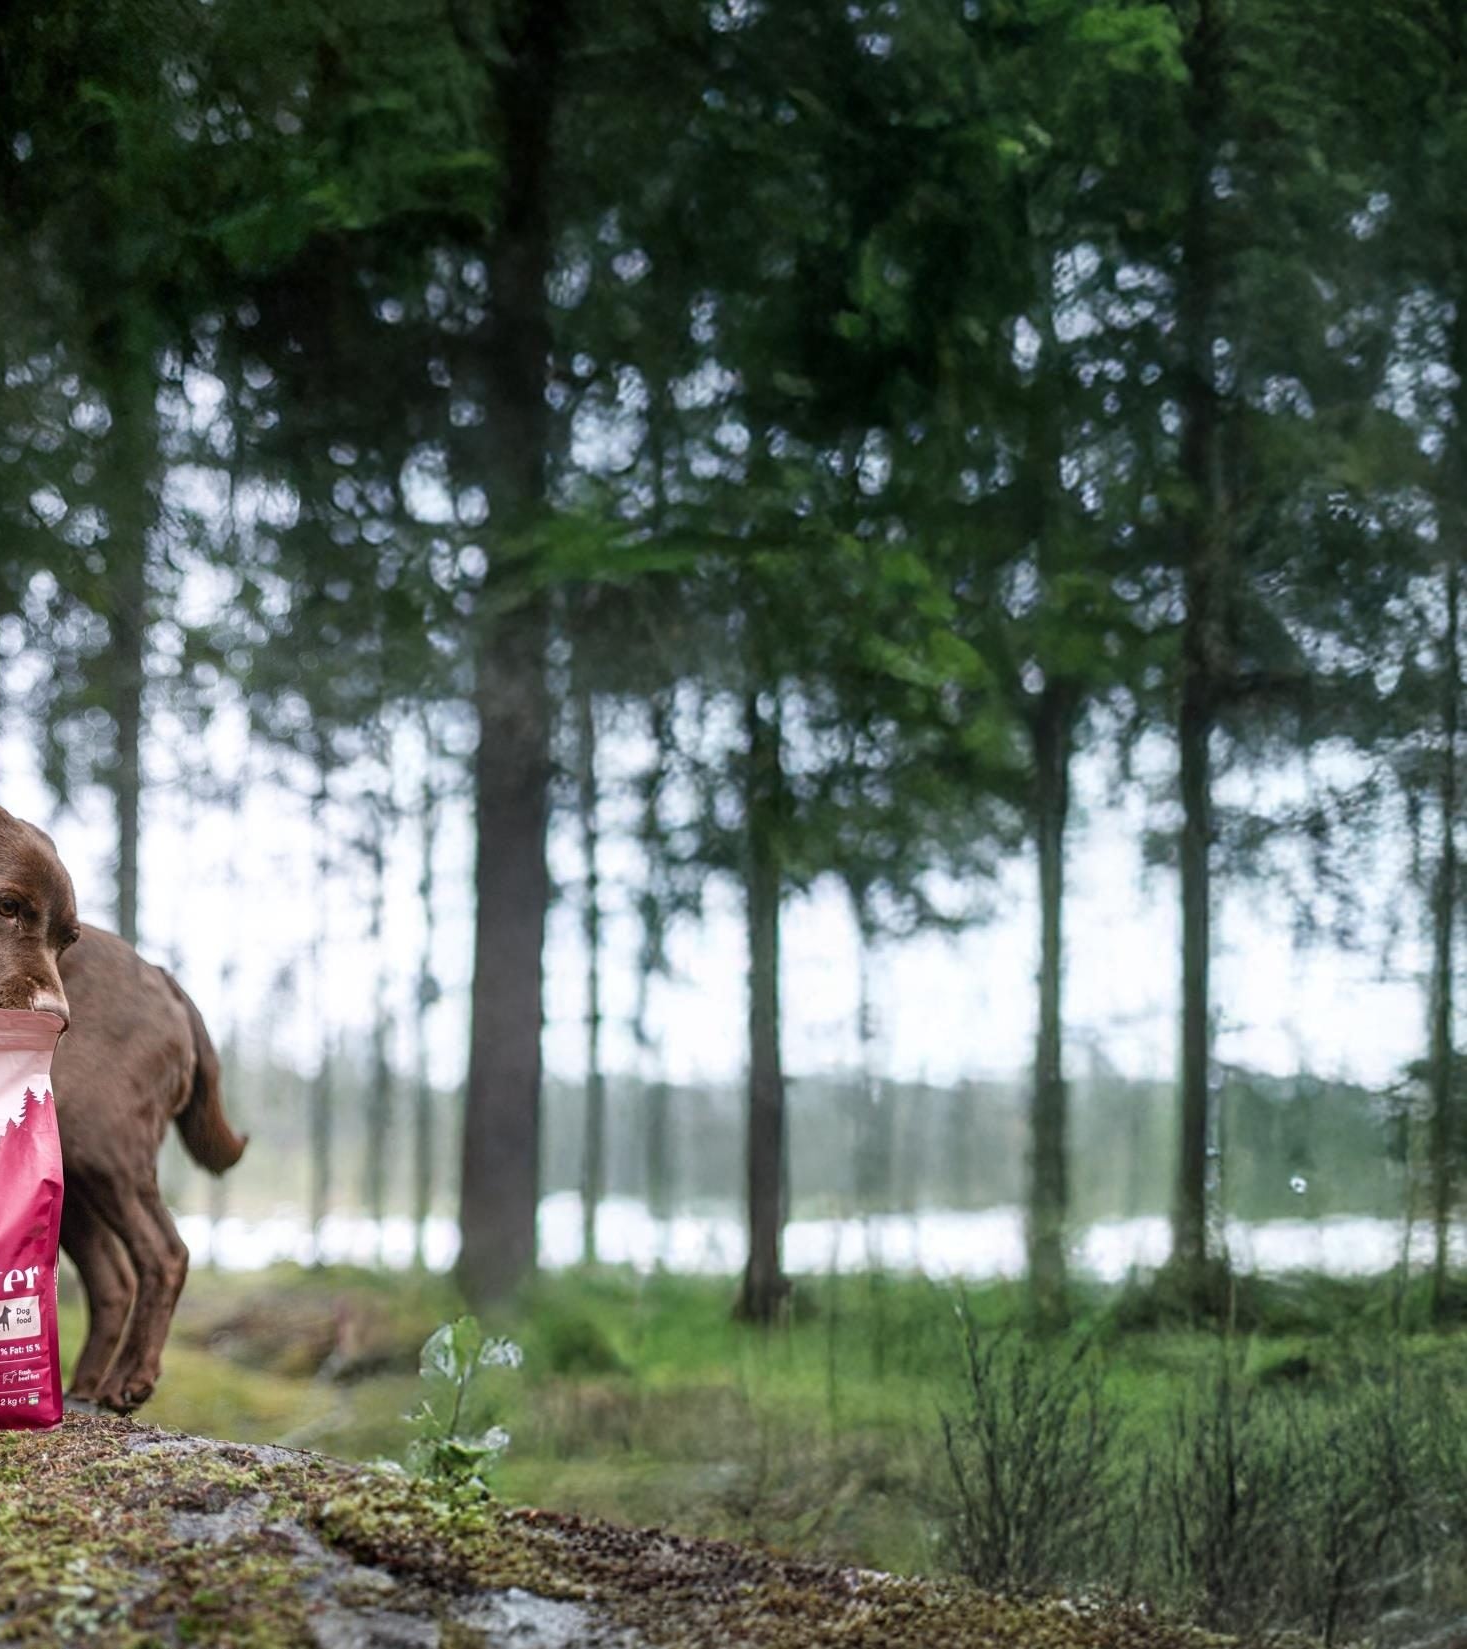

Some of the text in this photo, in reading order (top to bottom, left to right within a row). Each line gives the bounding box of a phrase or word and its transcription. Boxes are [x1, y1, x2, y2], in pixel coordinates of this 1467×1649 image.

[16, 1307, 31, 1316] Dog
[16, 1317, 32, 1325] food
[9, 1346, 25, 1355] Fat:
[26, 1344, 34, 1353] 15
[0, 1398, 6, 1406] 2
[7, 1397, 18, 1407] kg
